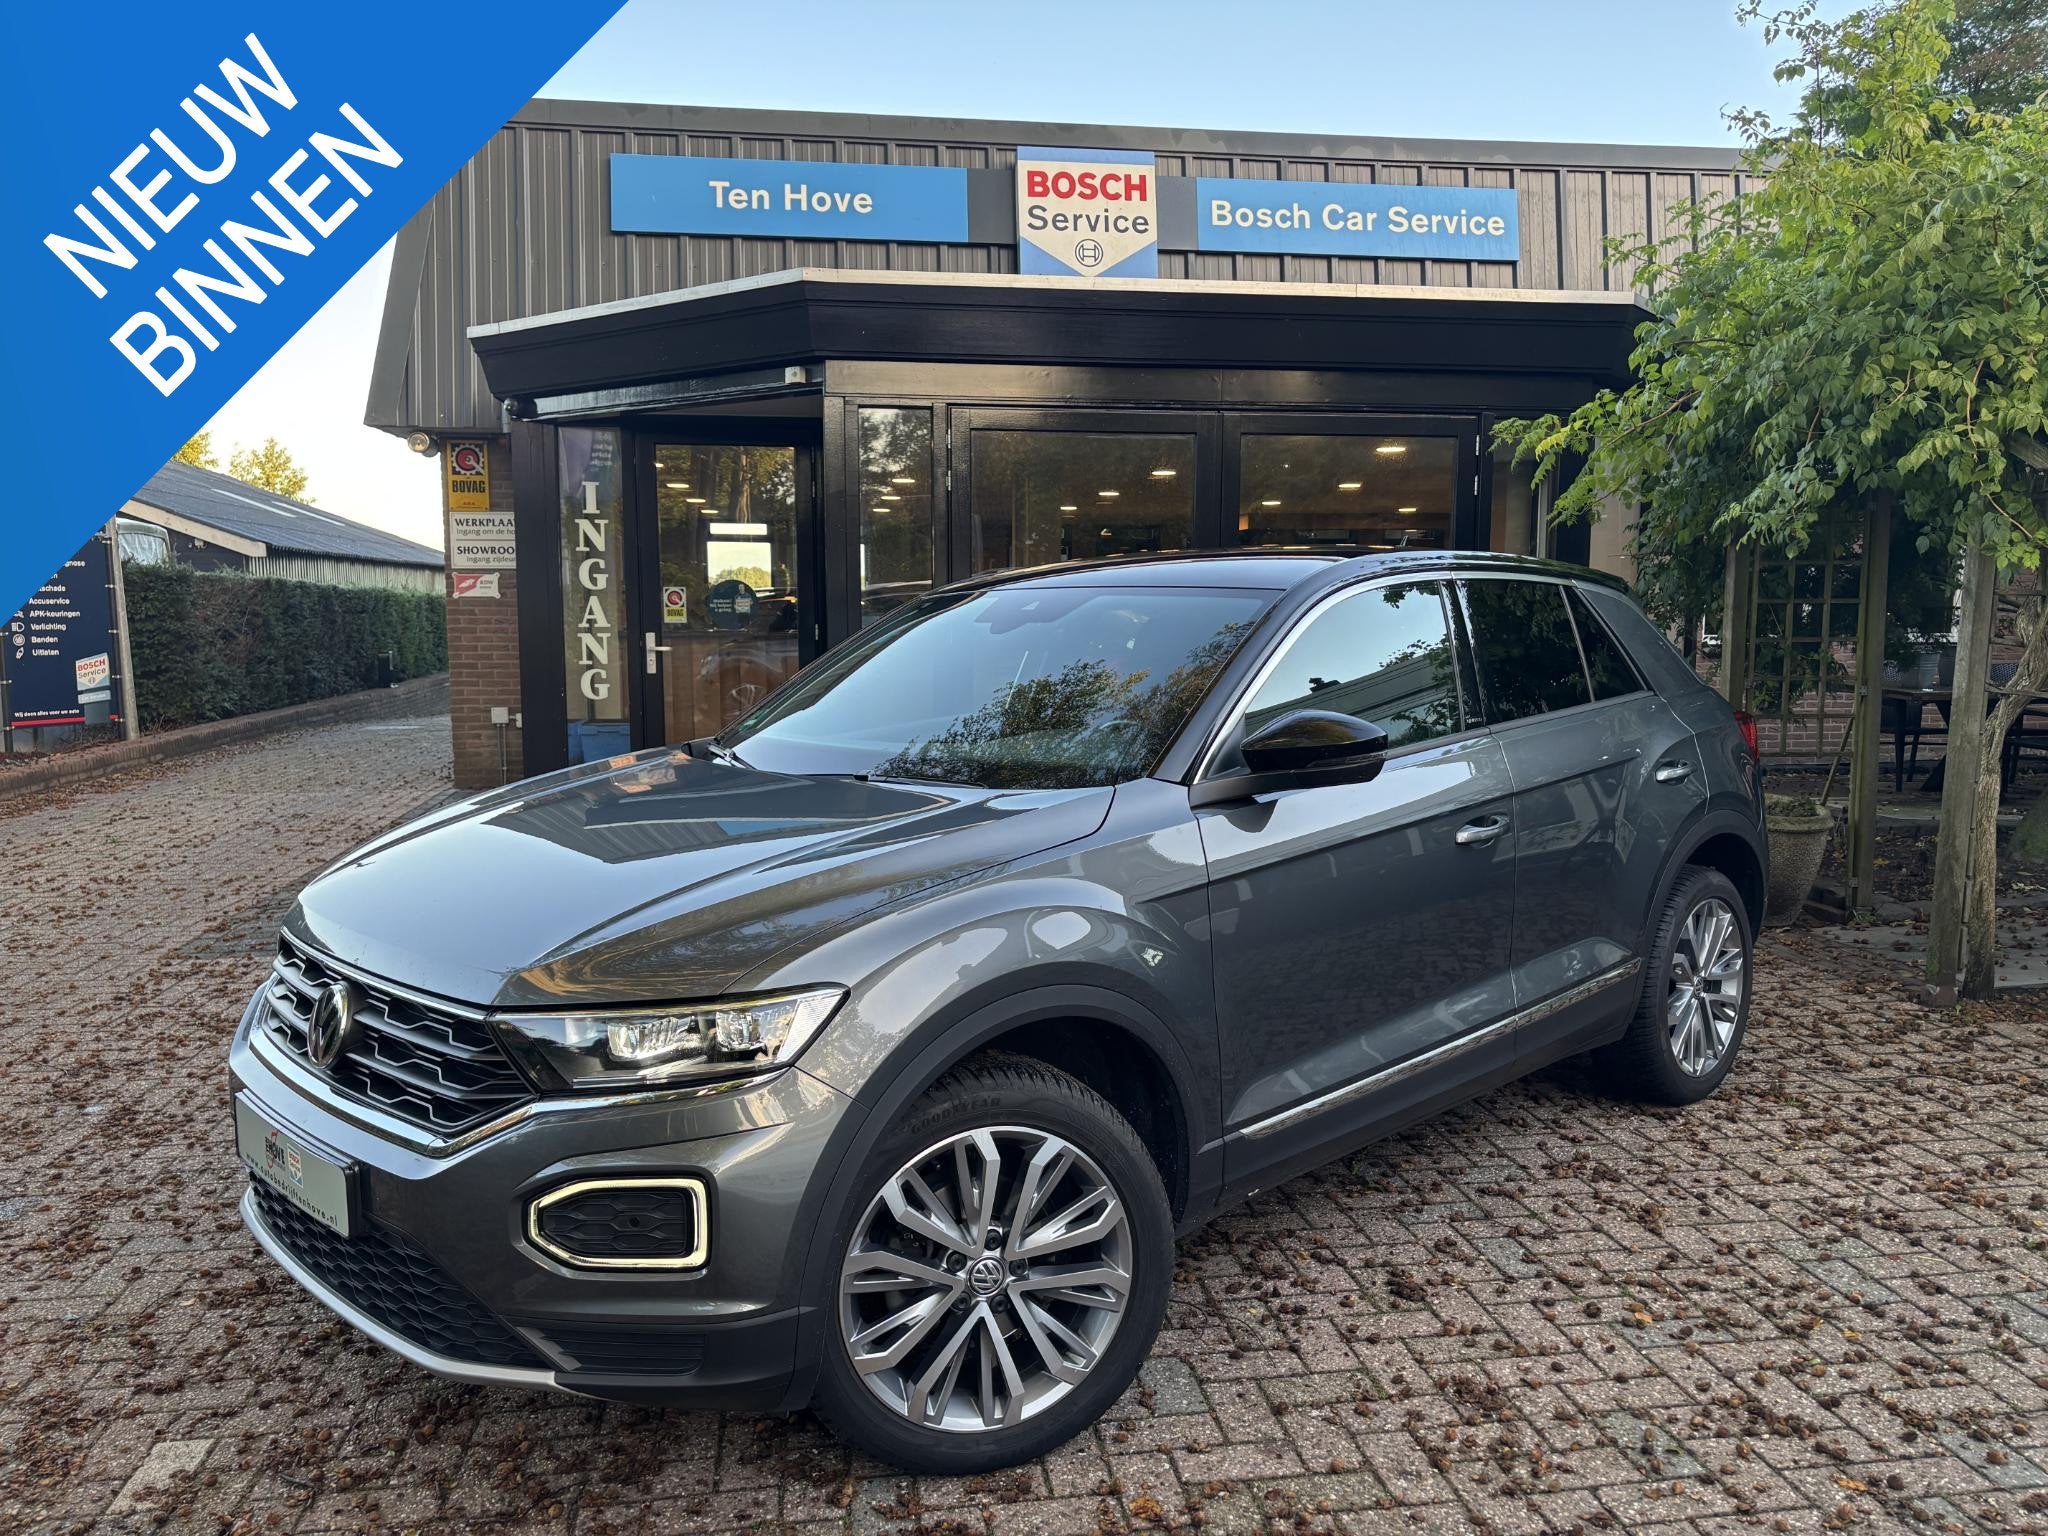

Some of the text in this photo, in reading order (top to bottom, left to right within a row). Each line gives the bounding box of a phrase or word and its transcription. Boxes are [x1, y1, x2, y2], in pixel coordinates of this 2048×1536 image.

[1027, 170, 1147, 201] BOSCH
[709, 180, 873, 214] Ten Hove
[1027, 205, 1149, 234] Service
[1211, 200, 1505, 236] Bosch Car Service
[452, 480, 486, 493] BOVAG
[455, 518, 516, 527] WERKPLAA
[457, 545, 515, 555] SHOWROO
[40, 584, 66, 592] schade
[574, 481, 611, 700] INGANG
[31, 635, 58, 643] Banden
[78, 658, 106, 672] BOSCH
[78, 668, 106, 679] Service
